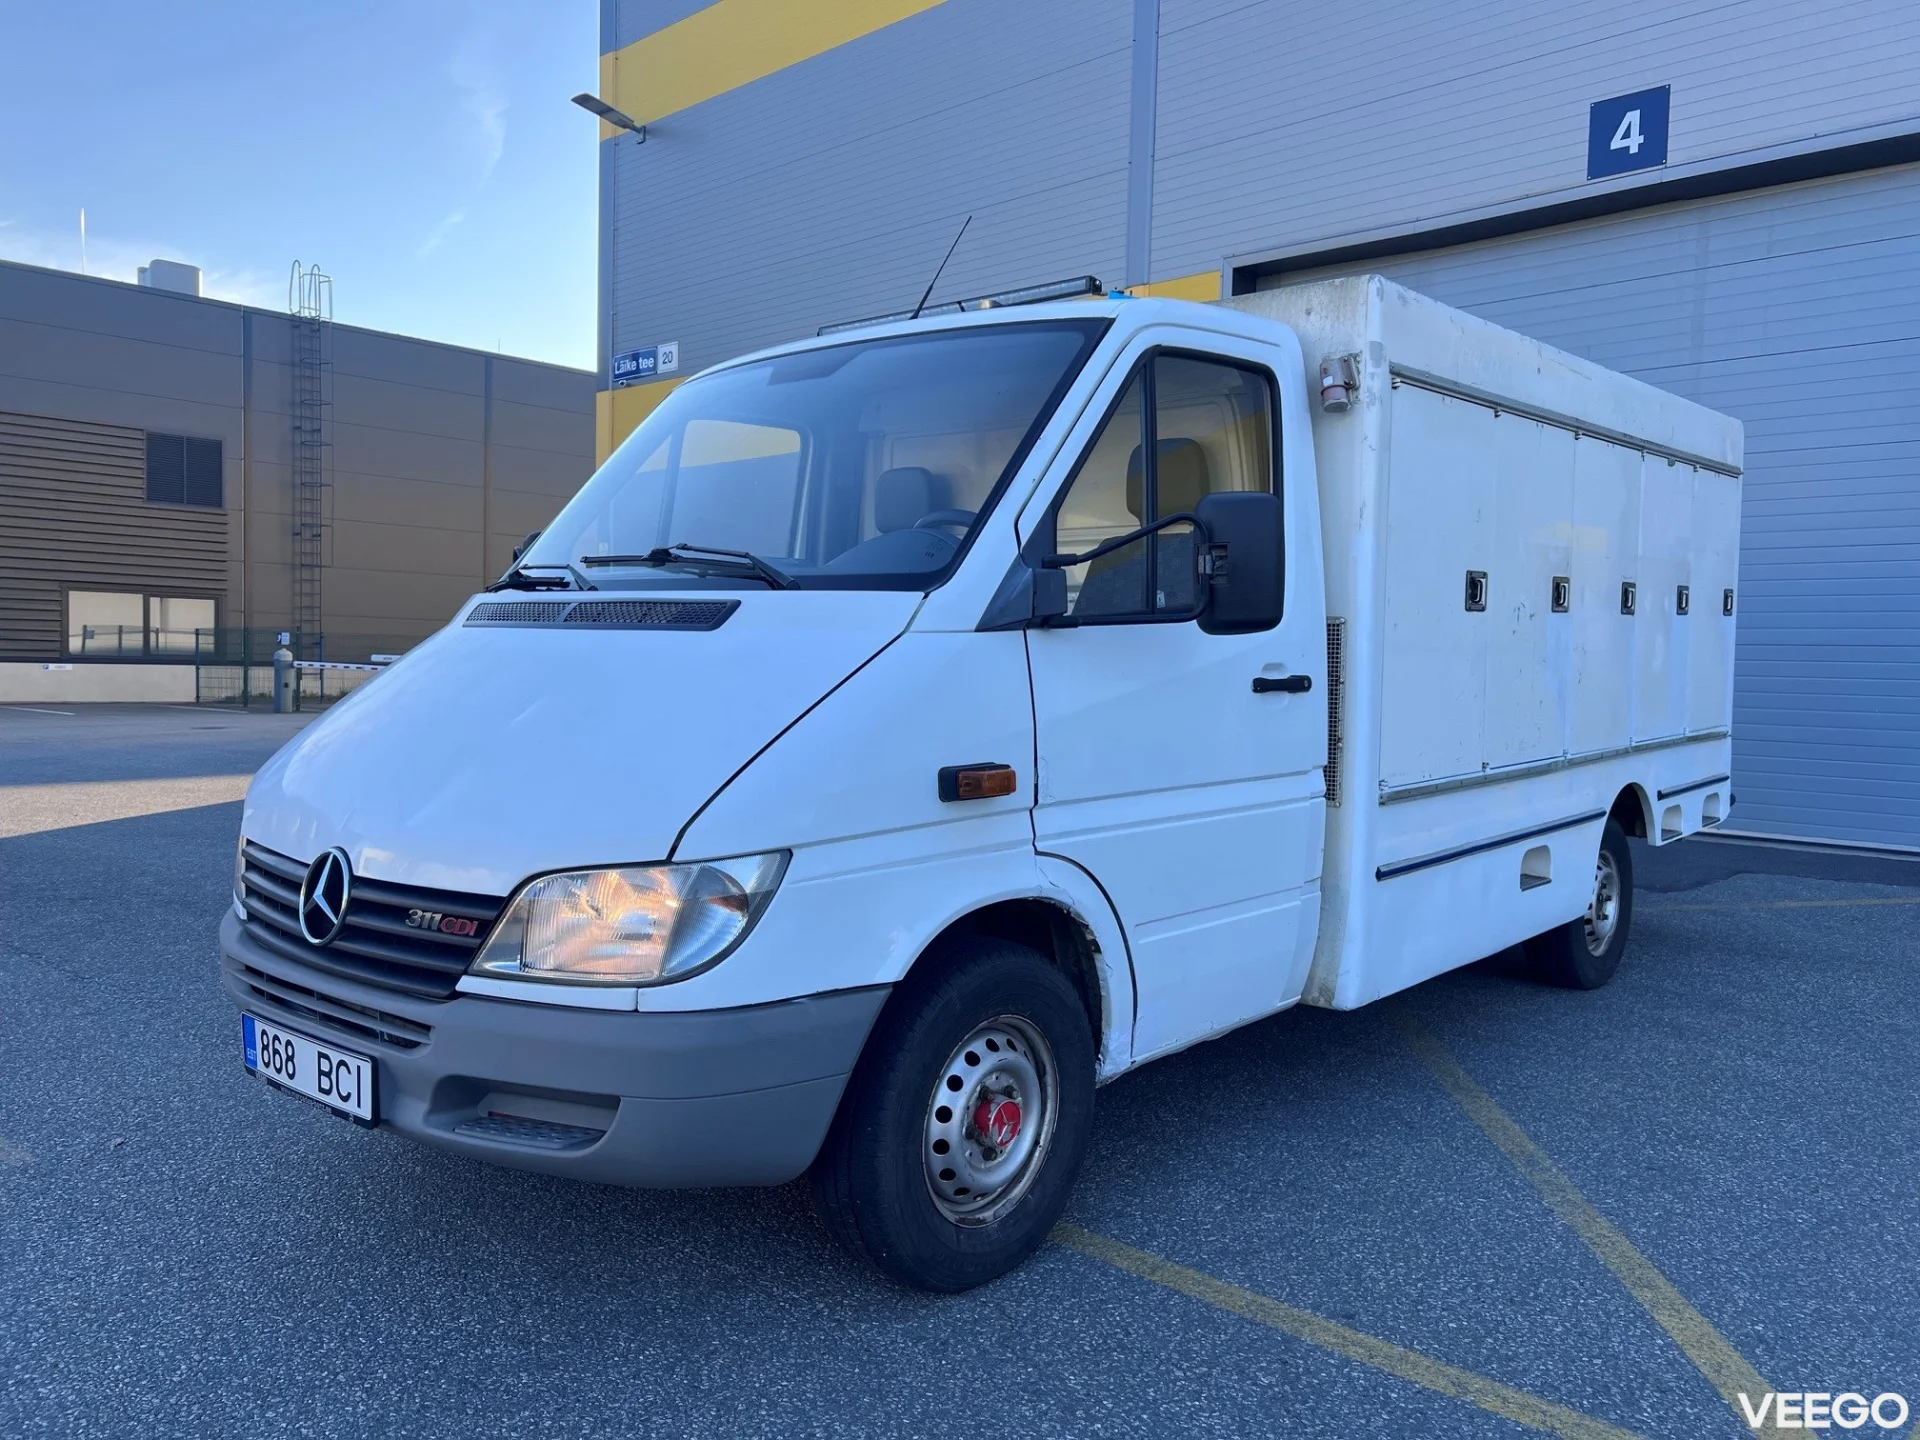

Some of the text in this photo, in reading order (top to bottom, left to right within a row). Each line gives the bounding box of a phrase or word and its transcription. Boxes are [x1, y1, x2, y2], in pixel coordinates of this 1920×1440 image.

[1609, 108, 1645, 155] 4
[614, 357, 654, 374] Läike tee
[662, 351, 673, 364] 20
[260, 1028, 297, 1081] 868
[317, 1050, 362, 1109] BCI
